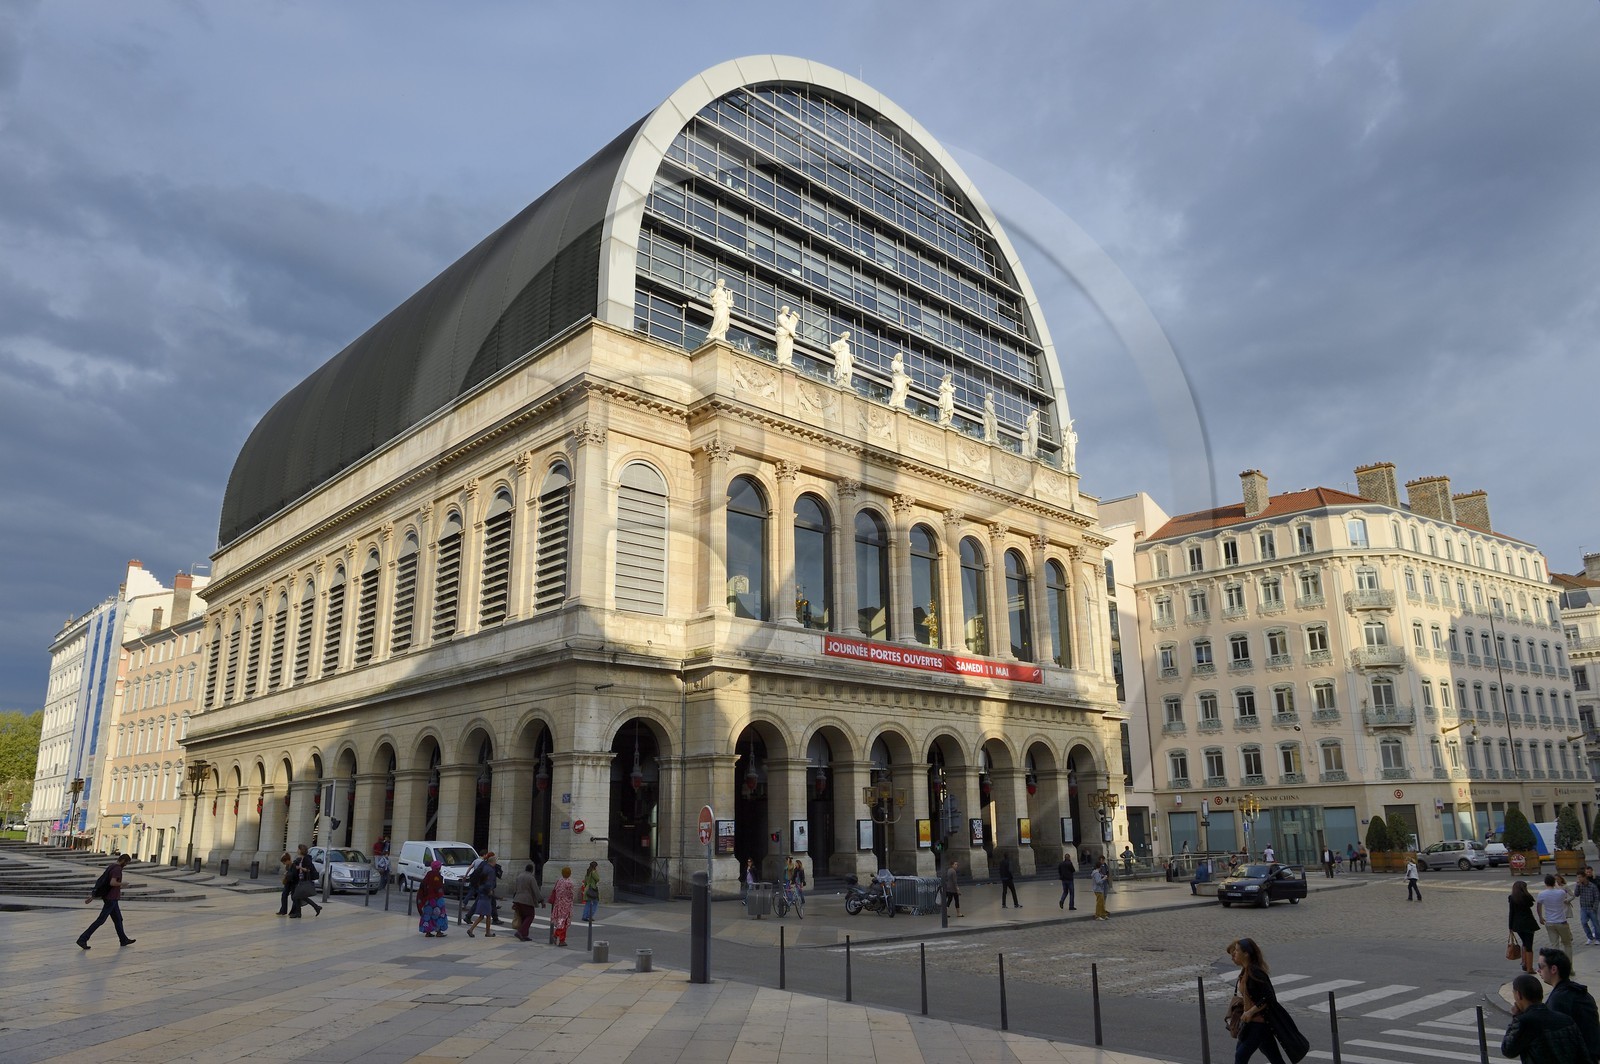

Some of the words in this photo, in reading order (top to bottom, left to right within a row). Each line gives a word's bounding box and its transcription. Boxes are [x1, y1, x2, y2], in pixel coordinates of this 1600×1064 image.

[828, 641, 868, 657] JOURNÉE
[870, 648, 901, 662] PORTES
[903, 653, 943, 668] OUVERTES
[956, 661, 983, 673] SAMEDI
[985, 665, 993, 674] 11
[996, 667, 1009, 676] MAI
